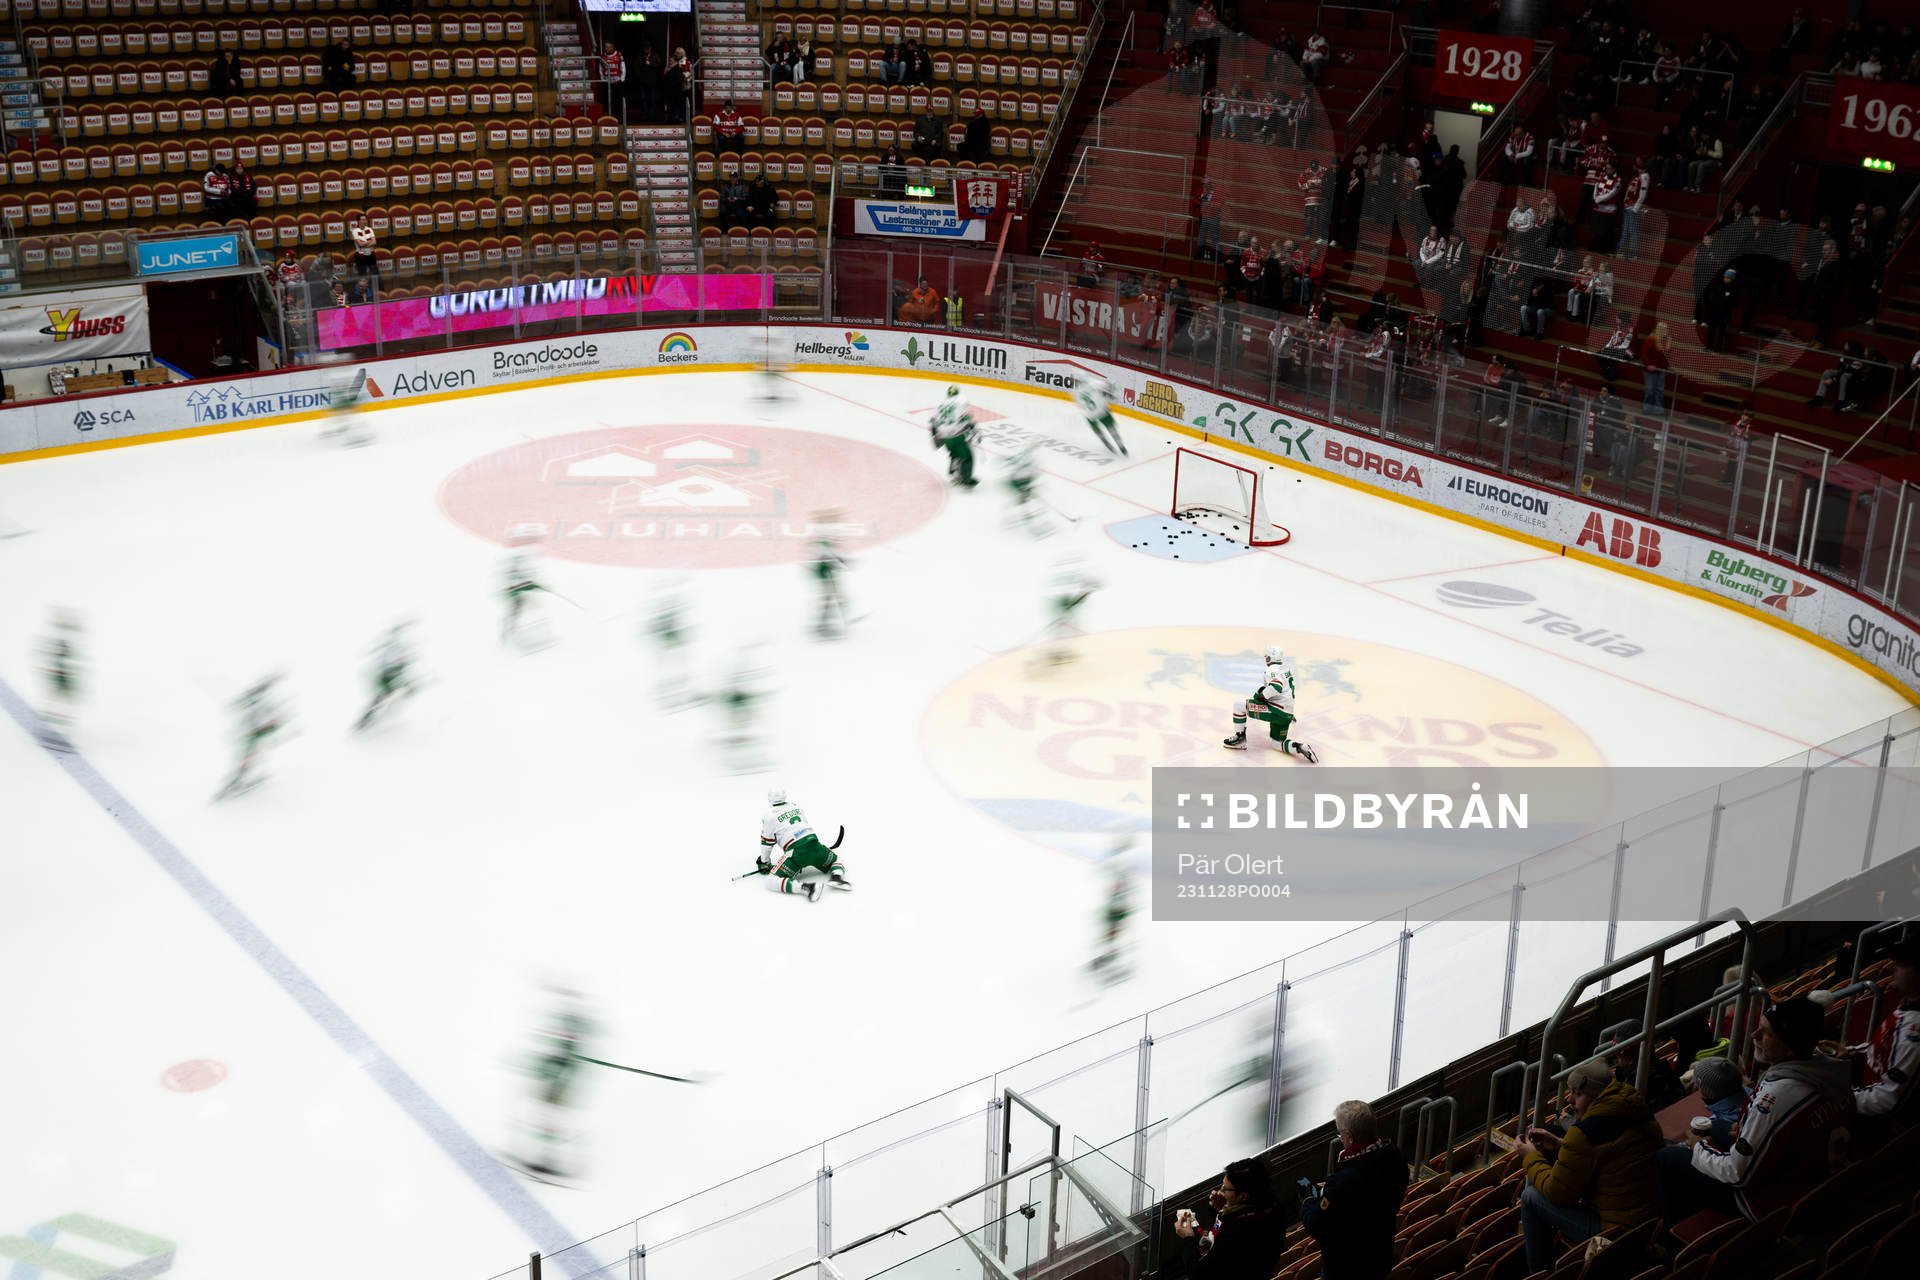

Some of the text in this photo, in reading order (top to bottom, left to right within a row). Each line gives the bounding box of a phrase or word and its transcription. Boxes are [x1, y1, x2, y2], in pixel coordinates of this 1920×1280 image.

[1443, 43, 1523, 82] 1928
[943, 219, 957, 228] AB
[142, 249, 222, 269] JUNET
[47, 307, 126, 343] Ybuss
[1043, 292, 1125, 333] VÄSTRA
[657, 352, 698, 363] Beckers
[795, 342, 852, 358] Hellbergs
[928, 340, 1007, 370] LILIUM
[392, 368, 475, 396] Adven
[1145, 380, 1175, 400] EURO
[100, 409, 136, 426] SCA
[202, 392, 332, 422] AB KARL HEDIN
[1215, 402, 1258, 444] GK
[1270, 419, 1314, 462] GK
[1324, 440, 1423, 488] BORGA
[1465, 478, 1549, 516] EUROCON
[511, 522, 869, 538] BAUHAUS
[1575, 511, 1662, 568] ABB
[1701, 569, 1764, 598] & Nordin
[1706, 550, 1788, 594] Byberg
[1522, 607, 1646, 660] Telia
[966, 691, 1559, 764] NORRANDS
